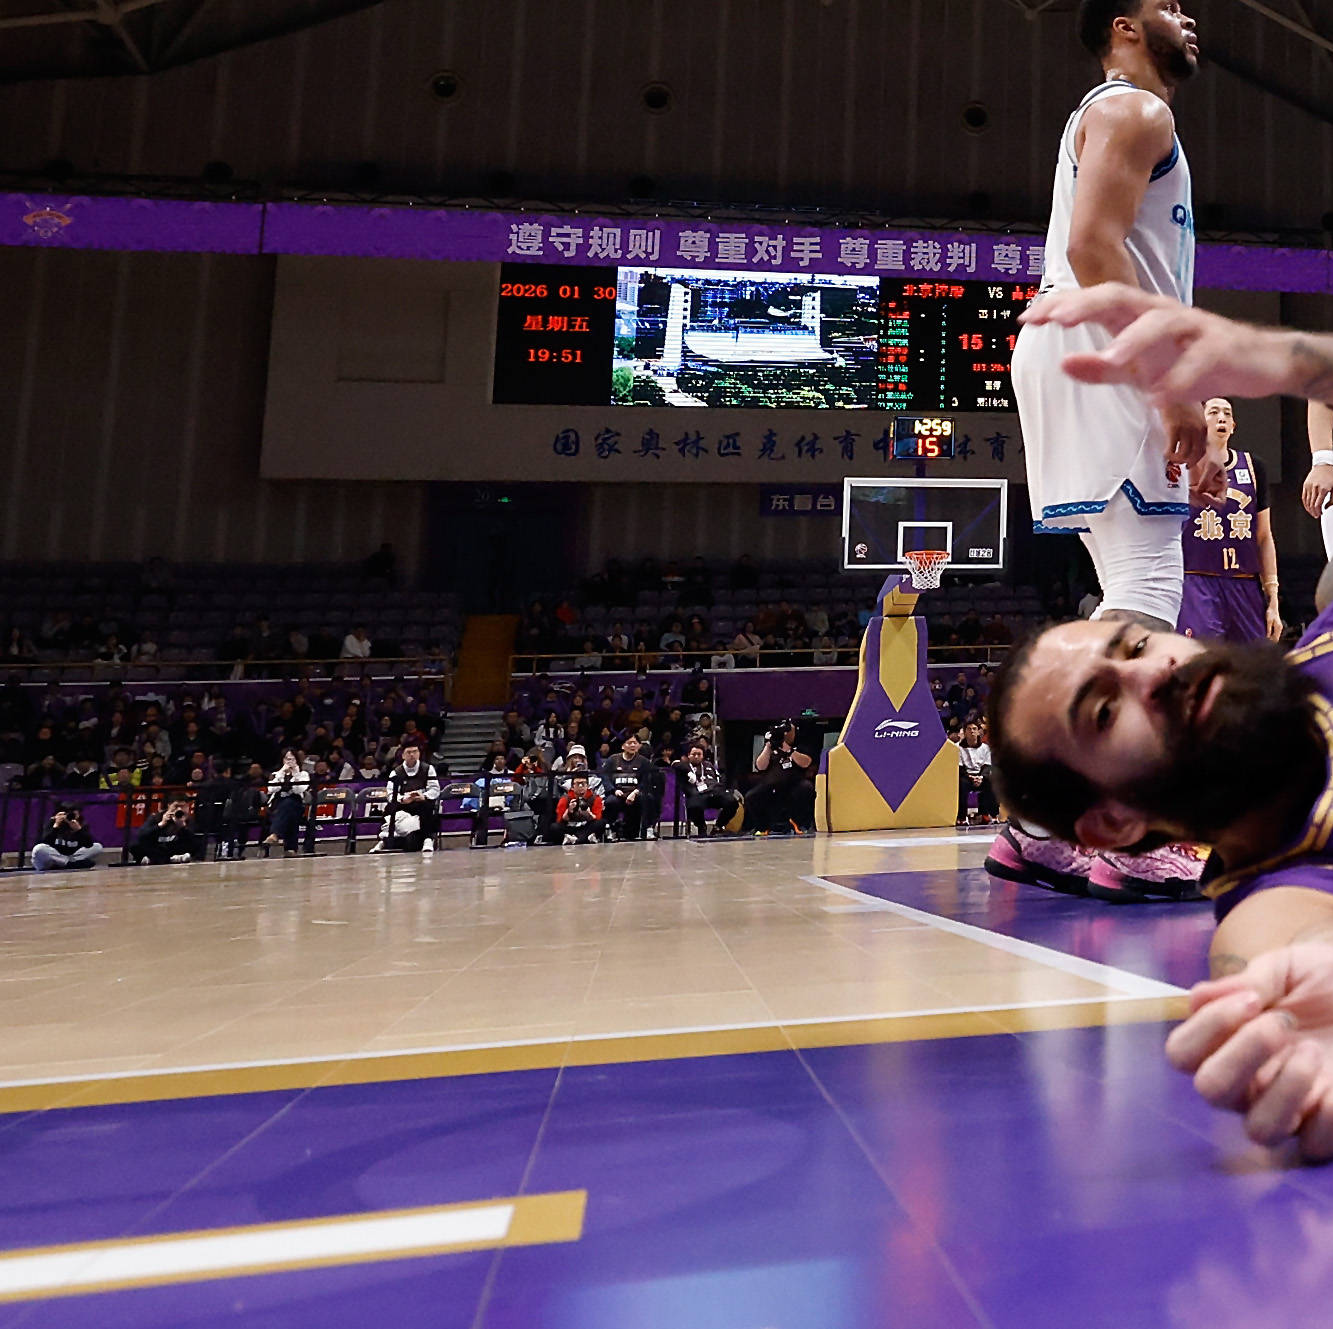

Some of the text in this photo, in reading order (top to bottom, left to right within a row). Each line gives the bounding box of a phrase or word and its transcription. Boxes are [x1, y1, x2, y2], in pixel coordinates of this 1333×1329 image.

[506, 223, 661, 261] 遵守规则
[676, 230, 823, 267] 尊重对手
[838, 237, 979, 274] 尊重裁判
[501, 283, 616, 301] 2026 01 30
[988, 286, 1004, 299] VS
[523, 314, 591, 333] 星期五
[958, 333, 984, 350] 15
[526, 348, 584, 364] 19:51
[917, 437, 940, 457] 15
[1193, 509, 1253, 541] 北京
[1222, 547, 1240, 570] 12
[874, 729, 920, 738] LI-NING
